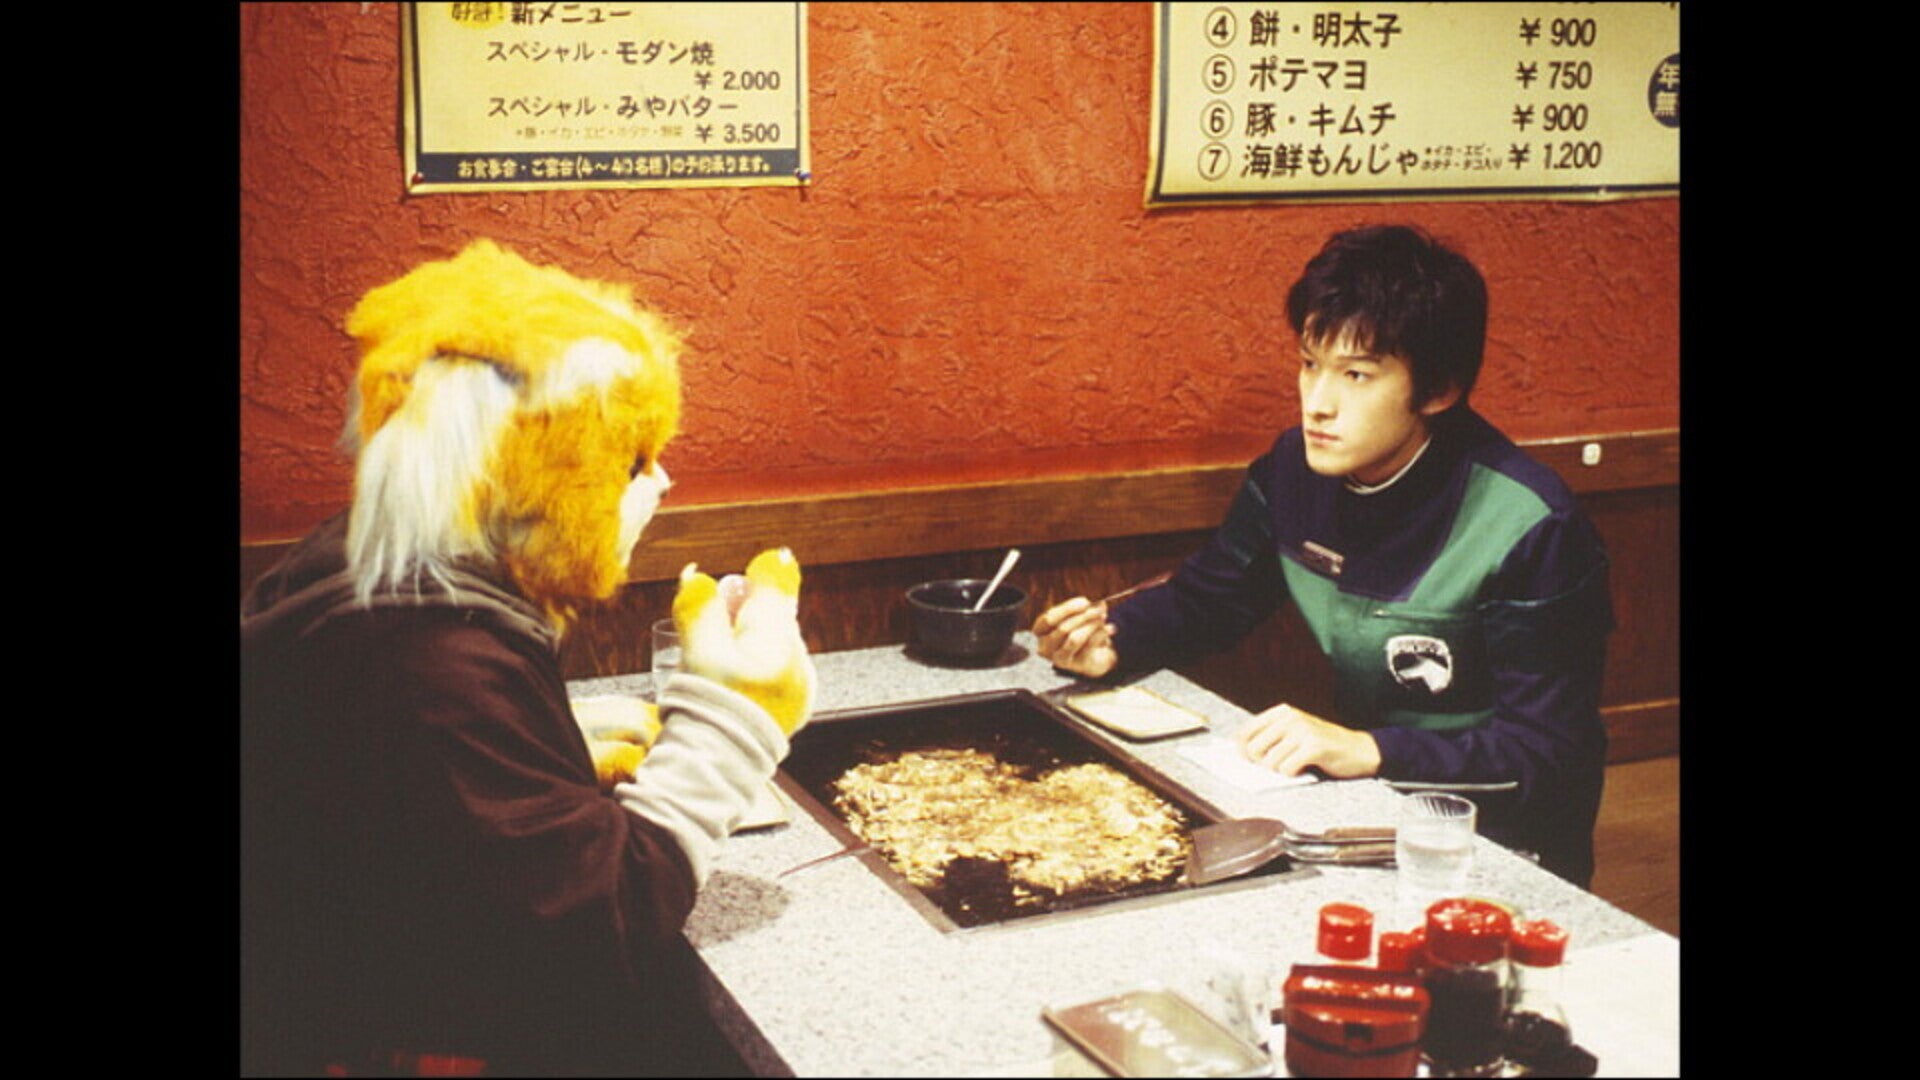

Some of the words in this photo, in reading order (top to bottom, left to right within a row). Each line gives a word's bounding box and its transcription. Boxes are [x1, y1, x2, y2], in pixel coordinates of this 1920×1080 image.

[1249, 10, 1402, 48] 餅・明太子
[1551, 17, 1597, 46] 900
[486, 40, 715, 65] スペシャル・モダン焼
[1248, 57, 1368, 91] ポテマヨ
[1549, 62, 1592, 90] 750
[488, 95, 738, 120] スペシャル・みやバター
[1245, 101, 1397, 137] 豚・キムチ
[1543, 103, 1589, 132] 900
[1240, 143, 1419, 178] 海鮮もんじゃ
